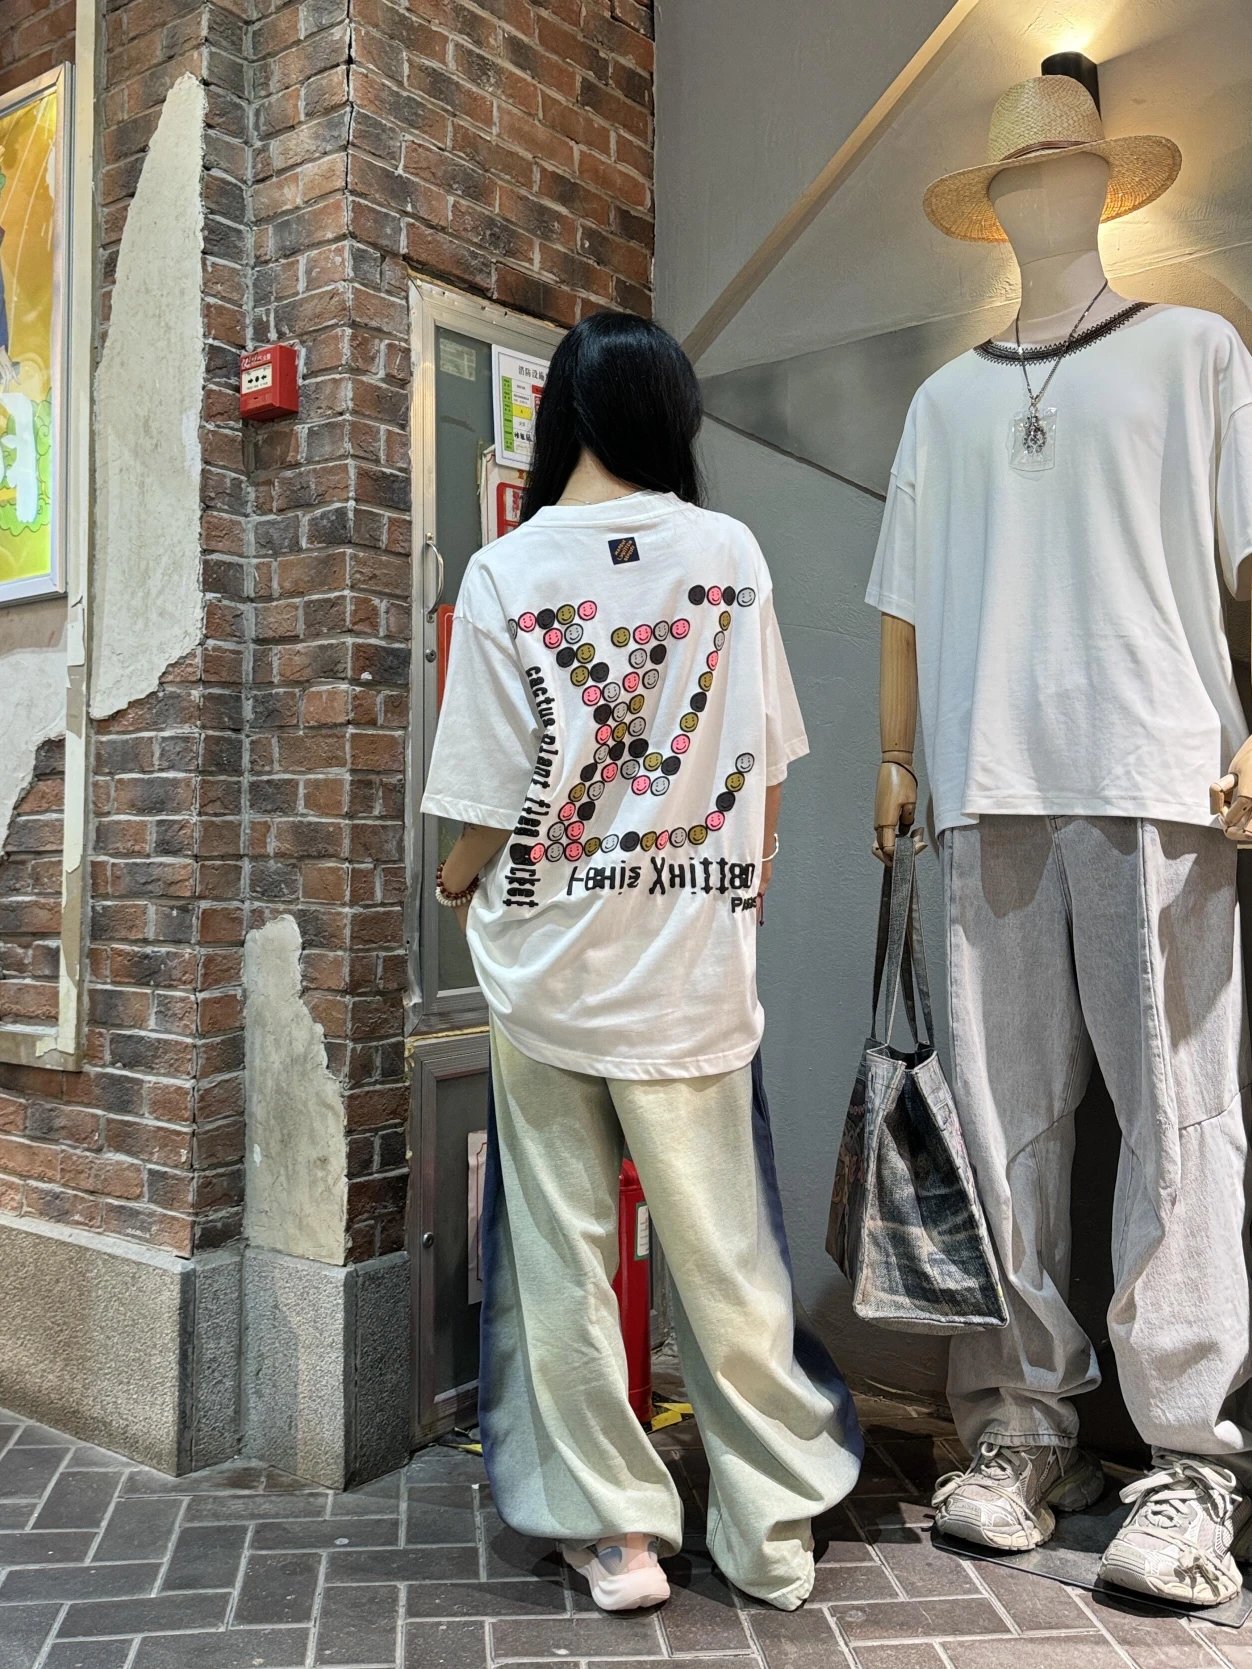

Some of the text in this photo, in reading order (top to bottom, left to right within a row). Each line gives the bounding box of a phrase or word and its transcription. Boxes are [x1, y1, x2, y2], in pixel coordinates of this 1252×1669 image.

[518, 365, 549, 381] 消防设施
[525, 666, 555, 728] cactus
[531, 734, 558, 789] plant
